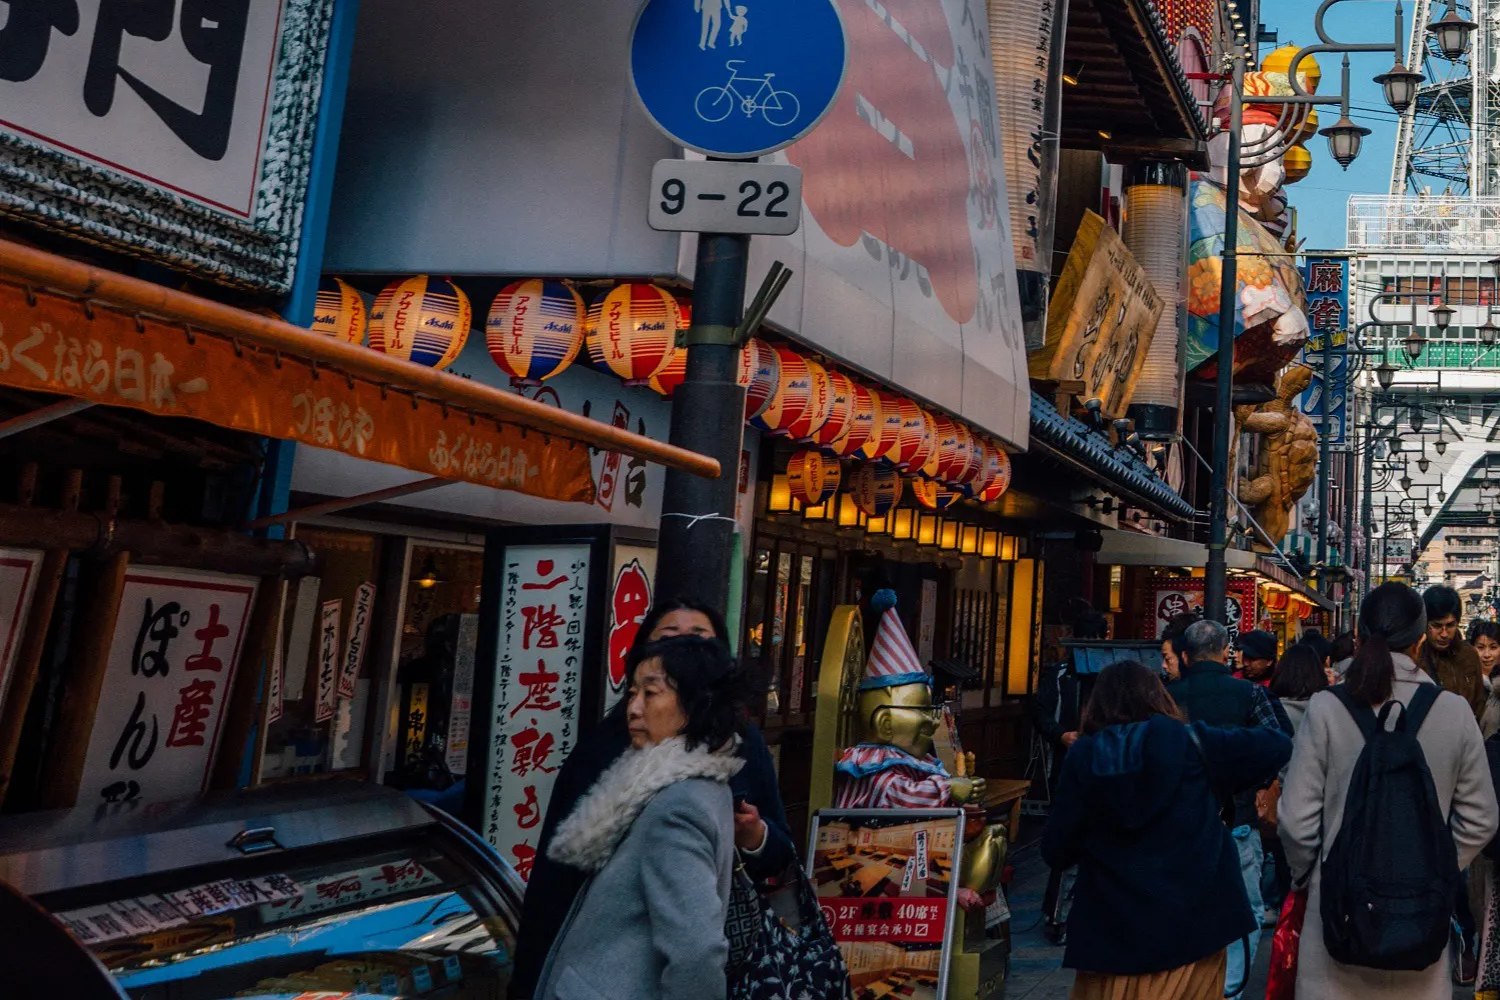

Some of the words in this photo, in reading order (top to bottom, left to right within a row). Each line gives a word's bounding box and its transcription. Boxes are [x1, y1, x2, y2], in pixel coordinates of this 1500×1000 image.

[1306, 260, 1344, 331] 麻雀
[313, 315, 336, 326] sahi
[424, 317, 455, 331] Asahi
[510, 295, 531, 356] アサヒビール
[543, 320, 574, 334] Asahi
[637, 321, 666, 332] Asahi
[165, 603, 231, 750] 土産
